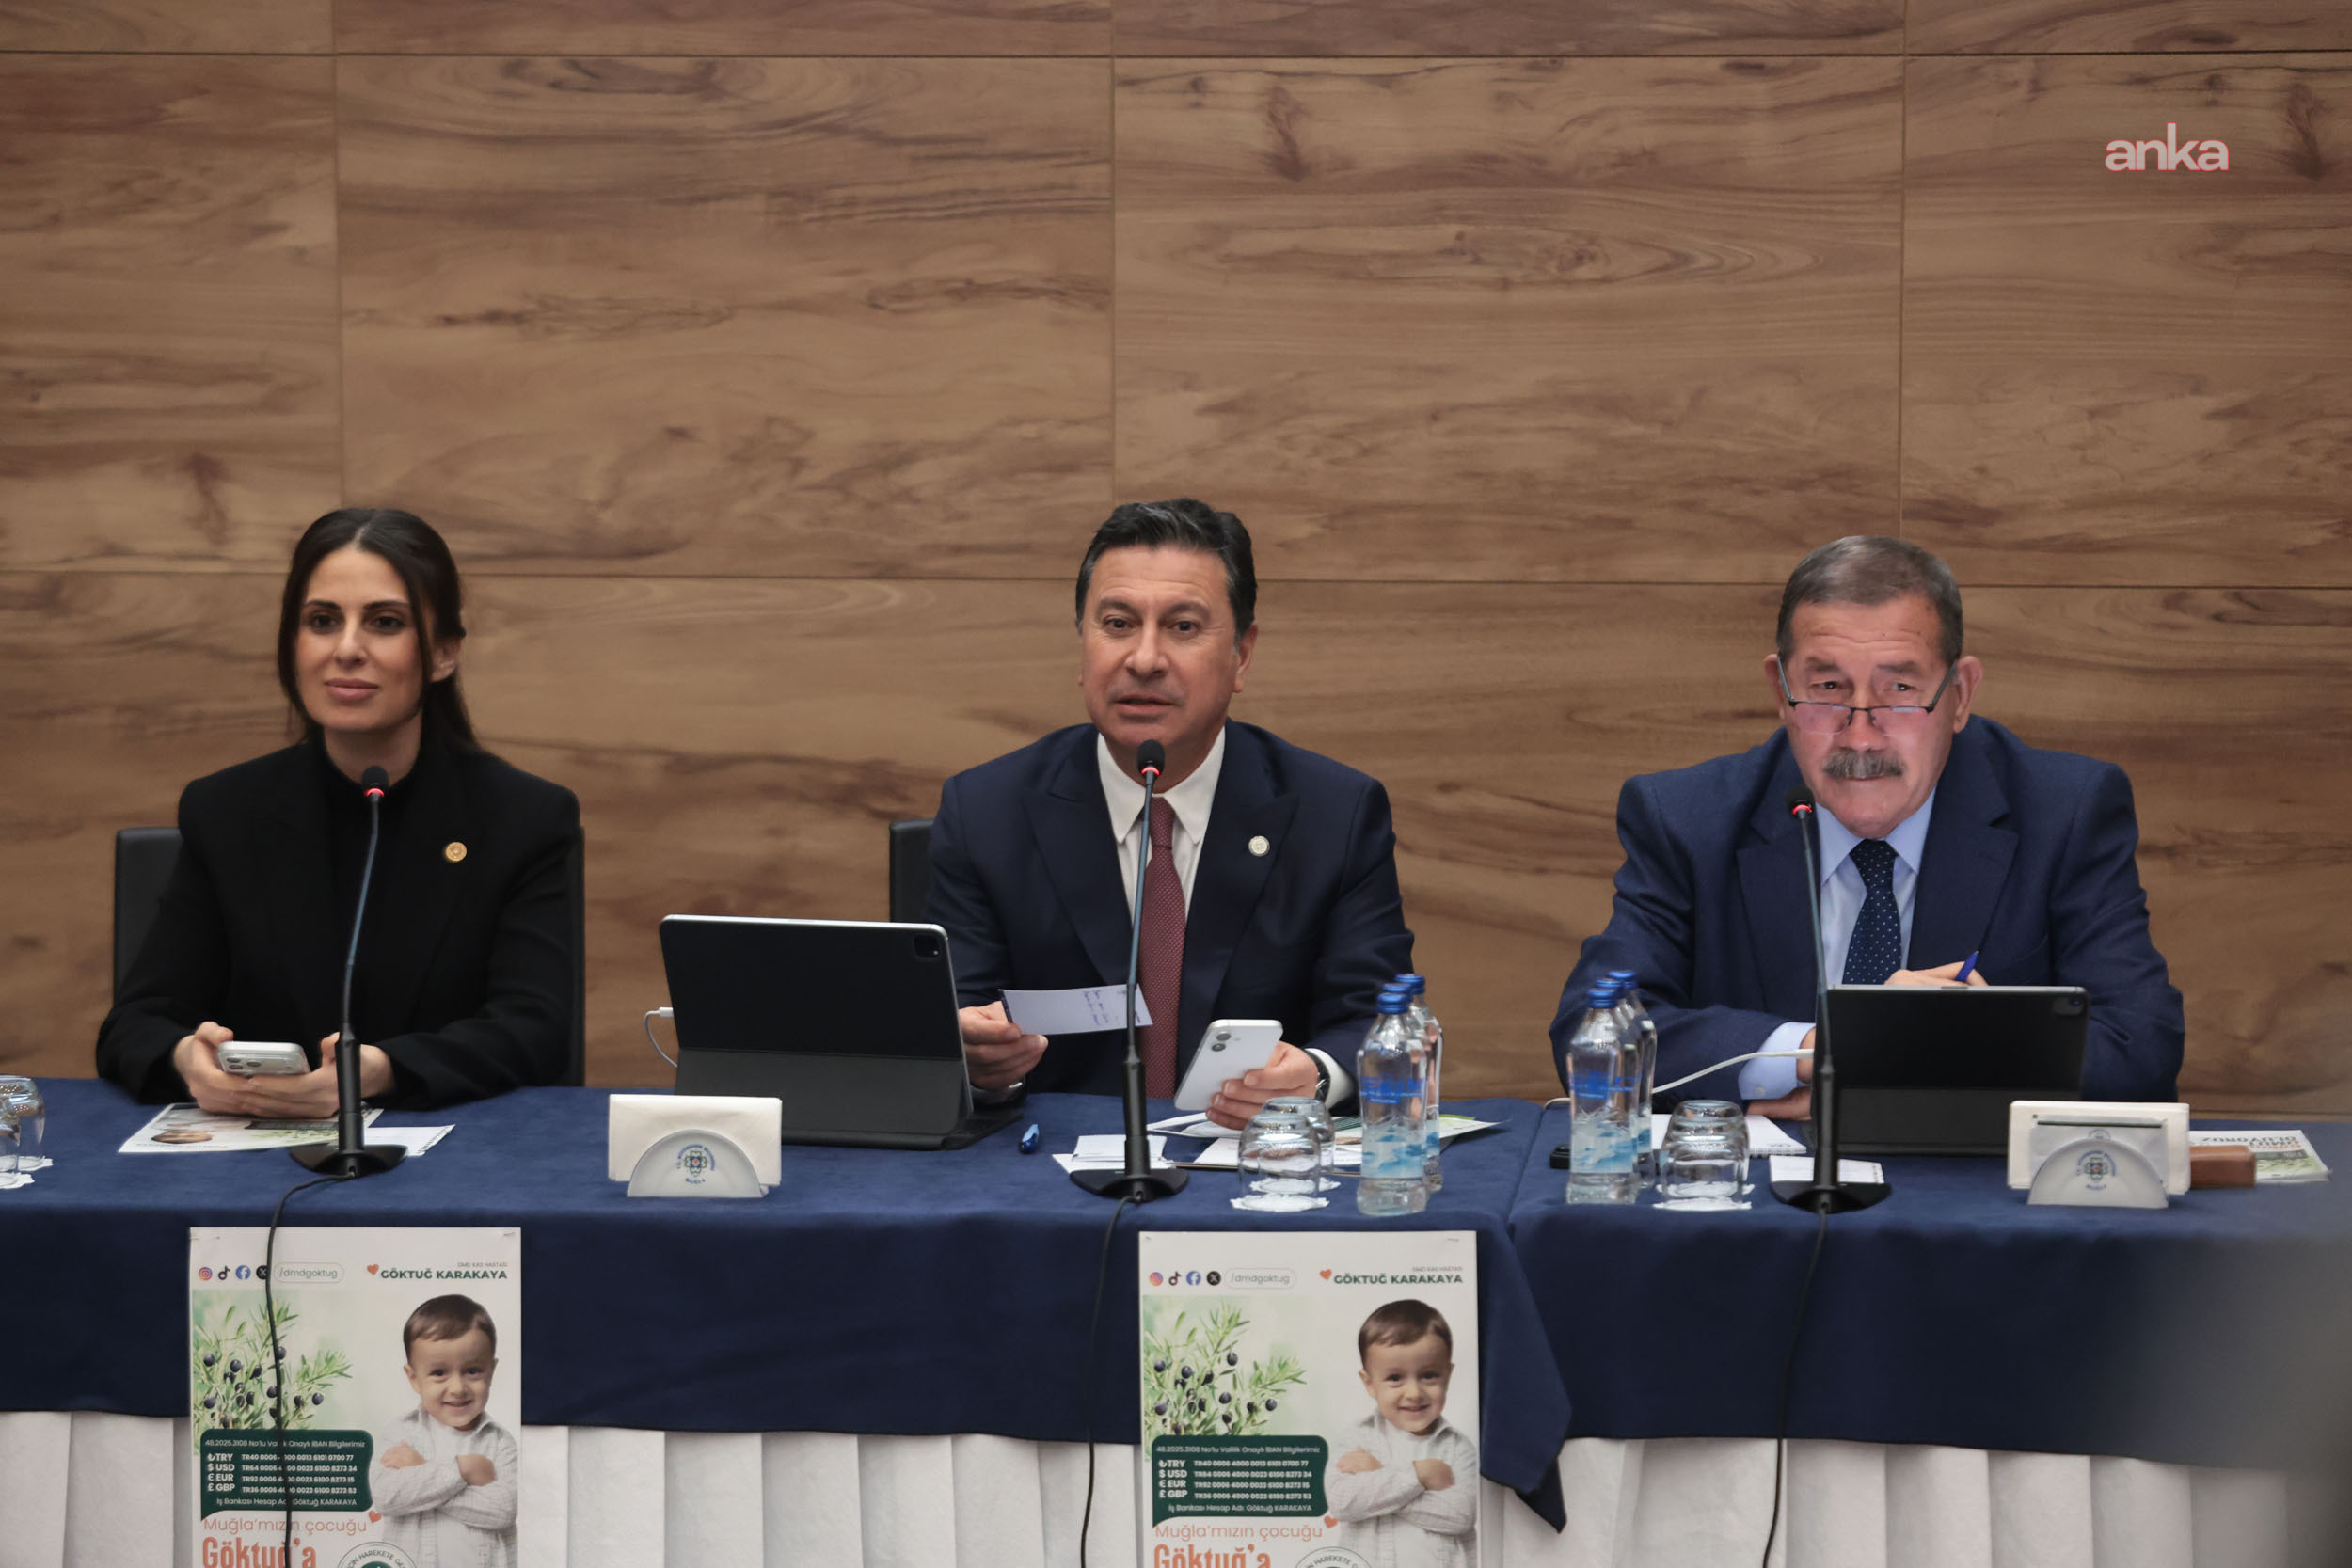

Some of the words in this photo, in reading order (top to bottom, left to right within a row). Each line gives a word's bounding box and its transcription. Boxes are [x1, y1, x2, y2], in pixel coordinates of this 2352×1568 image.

[278, 1267, 338, 1279] /dmdgoktug
[380, 1267, 433, 1279] GÖKTUĞ
[436, 1270, 508, 1279] KARAKAYA
[1333, 1272, 1388, 1285] GÖKTUĞ
[1391, 1274, 1464, 1284] KARAKAYA
[215, 1464, 235, 1472] USD
[215, 1473, 234, 1481] EUR
[1168, 1469, 1188, 1479] USD
[215, 1483, 236, 1492] GBP
[1168, 1480, 1186, 1488] EUR
[1168, 1490, 1188, 1498] GBP
[203, 1518, 300, 1535] Muğla'mızn
[305, 1519, 367, 1535] çocuğu
[1154, 1525, 1254, 1542] Muğla'mızın
[1259, 1525, 1323, 1542] çocuğu
[358, 1549, 394, 1560] HAREKETE
